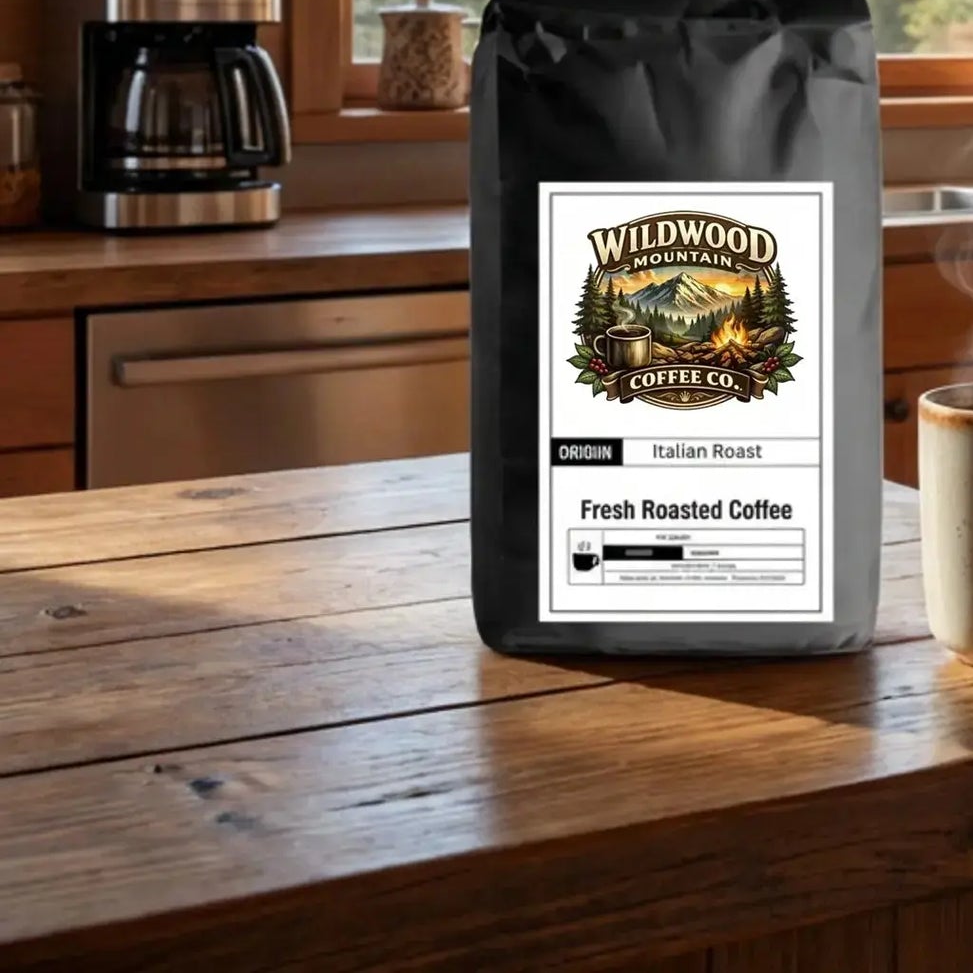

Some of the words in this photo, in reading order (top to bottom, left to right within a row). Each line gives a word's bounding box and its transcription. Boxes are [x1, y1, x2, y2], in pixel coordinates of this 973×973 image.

[591, 221, 775, 265] WILDWOOD
[634, 251, 732, 267] MOUNTAIN
[630, 370, 702, 390] COFFEE
[653, 443, 707, 459] Italian
[713, 444, 762, 459] Roast
[581, 499, 635, 520] Fresh
[642, 499, 722, 520] Roasted
[729, 499, 793, 520] Coffee
